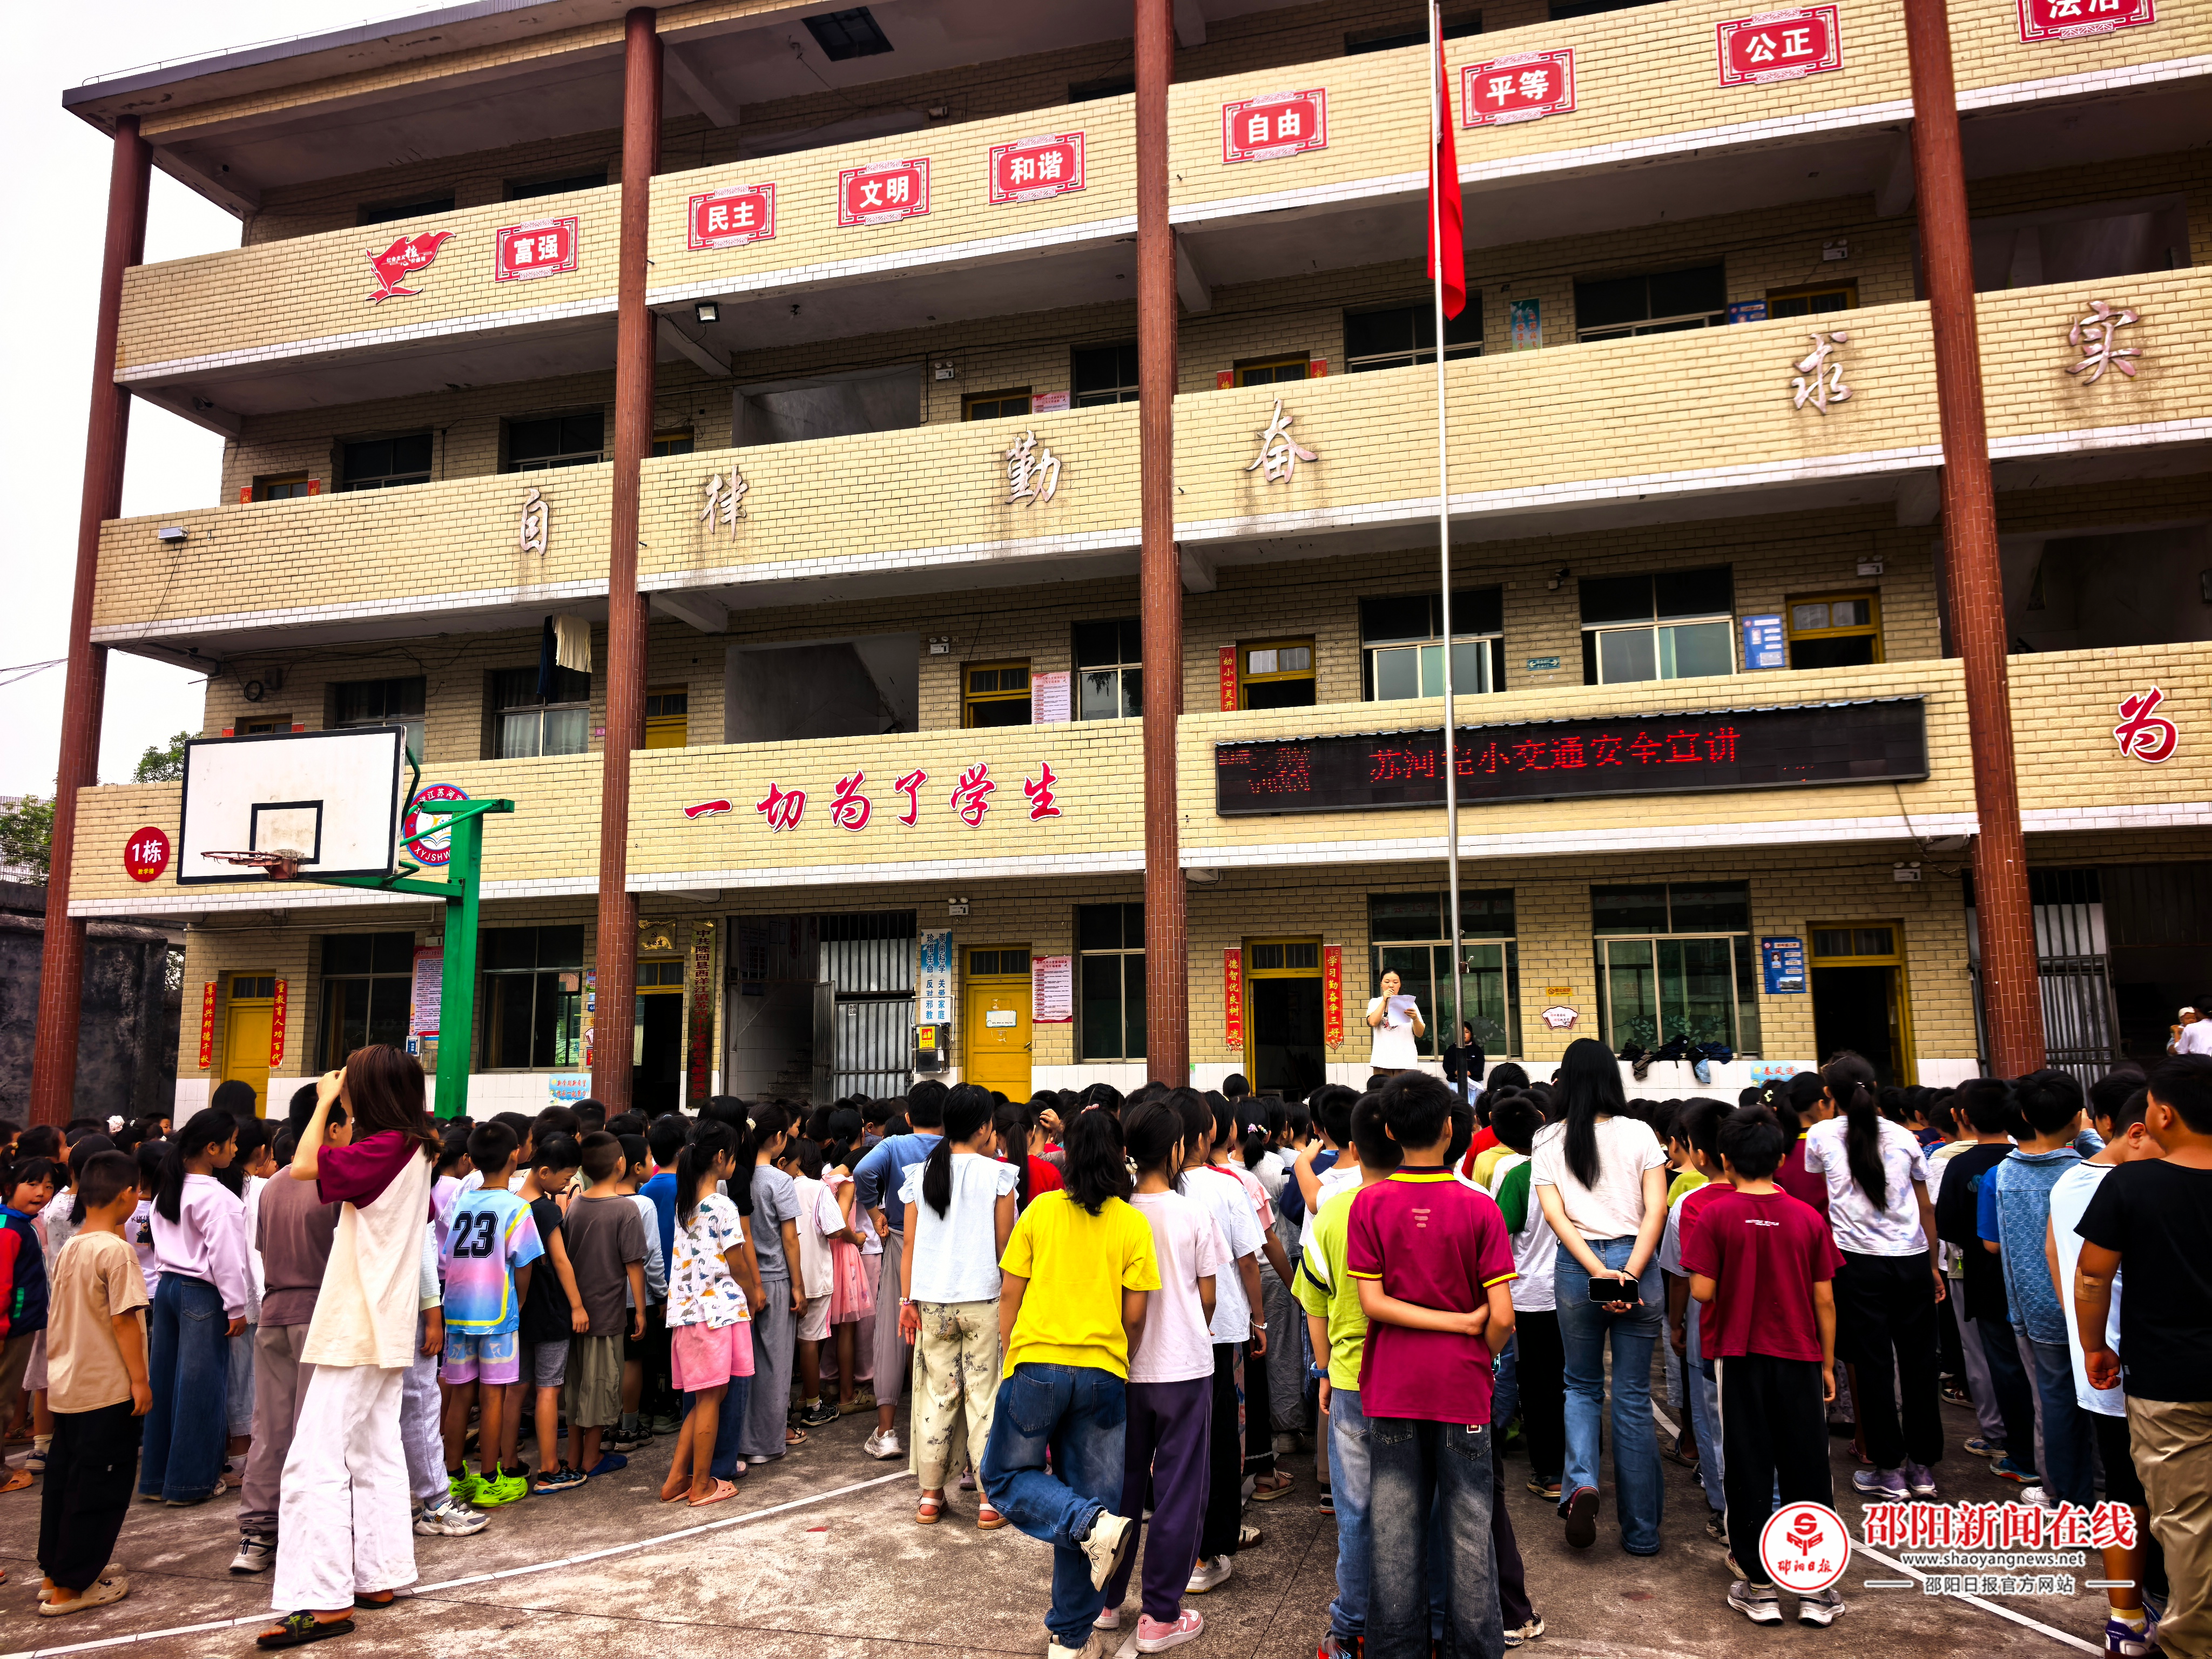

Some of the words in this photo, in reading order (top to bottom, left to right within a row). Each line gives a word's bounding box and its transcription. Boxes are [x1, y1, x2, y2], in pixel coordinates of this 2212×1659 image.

[1746, 28, 1813, 63] 公正
[1487, 70, 1548, 105] 平等
[1247, 109, 1301, 144] 自由
[1010, 152, 1063, 184] 和谐
[860, 177, 909, 208] 文明
[708, 202, 755, 232] 民主
[514, 234, 558, 264] 富强
[1005, 429, 1061, 507] 勤
[2066, 300, 2141, 385] 实
[1223, 657, 1234, 710] 幼小心灵开
[2113, 686, 2179, 763] 为
[683, 761, 1063, 834] 一切为了学生
[132, 840, 162, 863] 1栋
[1229, 959, 1240, 1039] 德智优良树一流
[1328, 956, 1340, 1037] 学习勤奋争三好
[200, 984, 214, 1063] 尊师兴邦德千秋
[272, 983, 286, 1062] 重教育人功百代
[453, 1211, 498, 1258] 23
